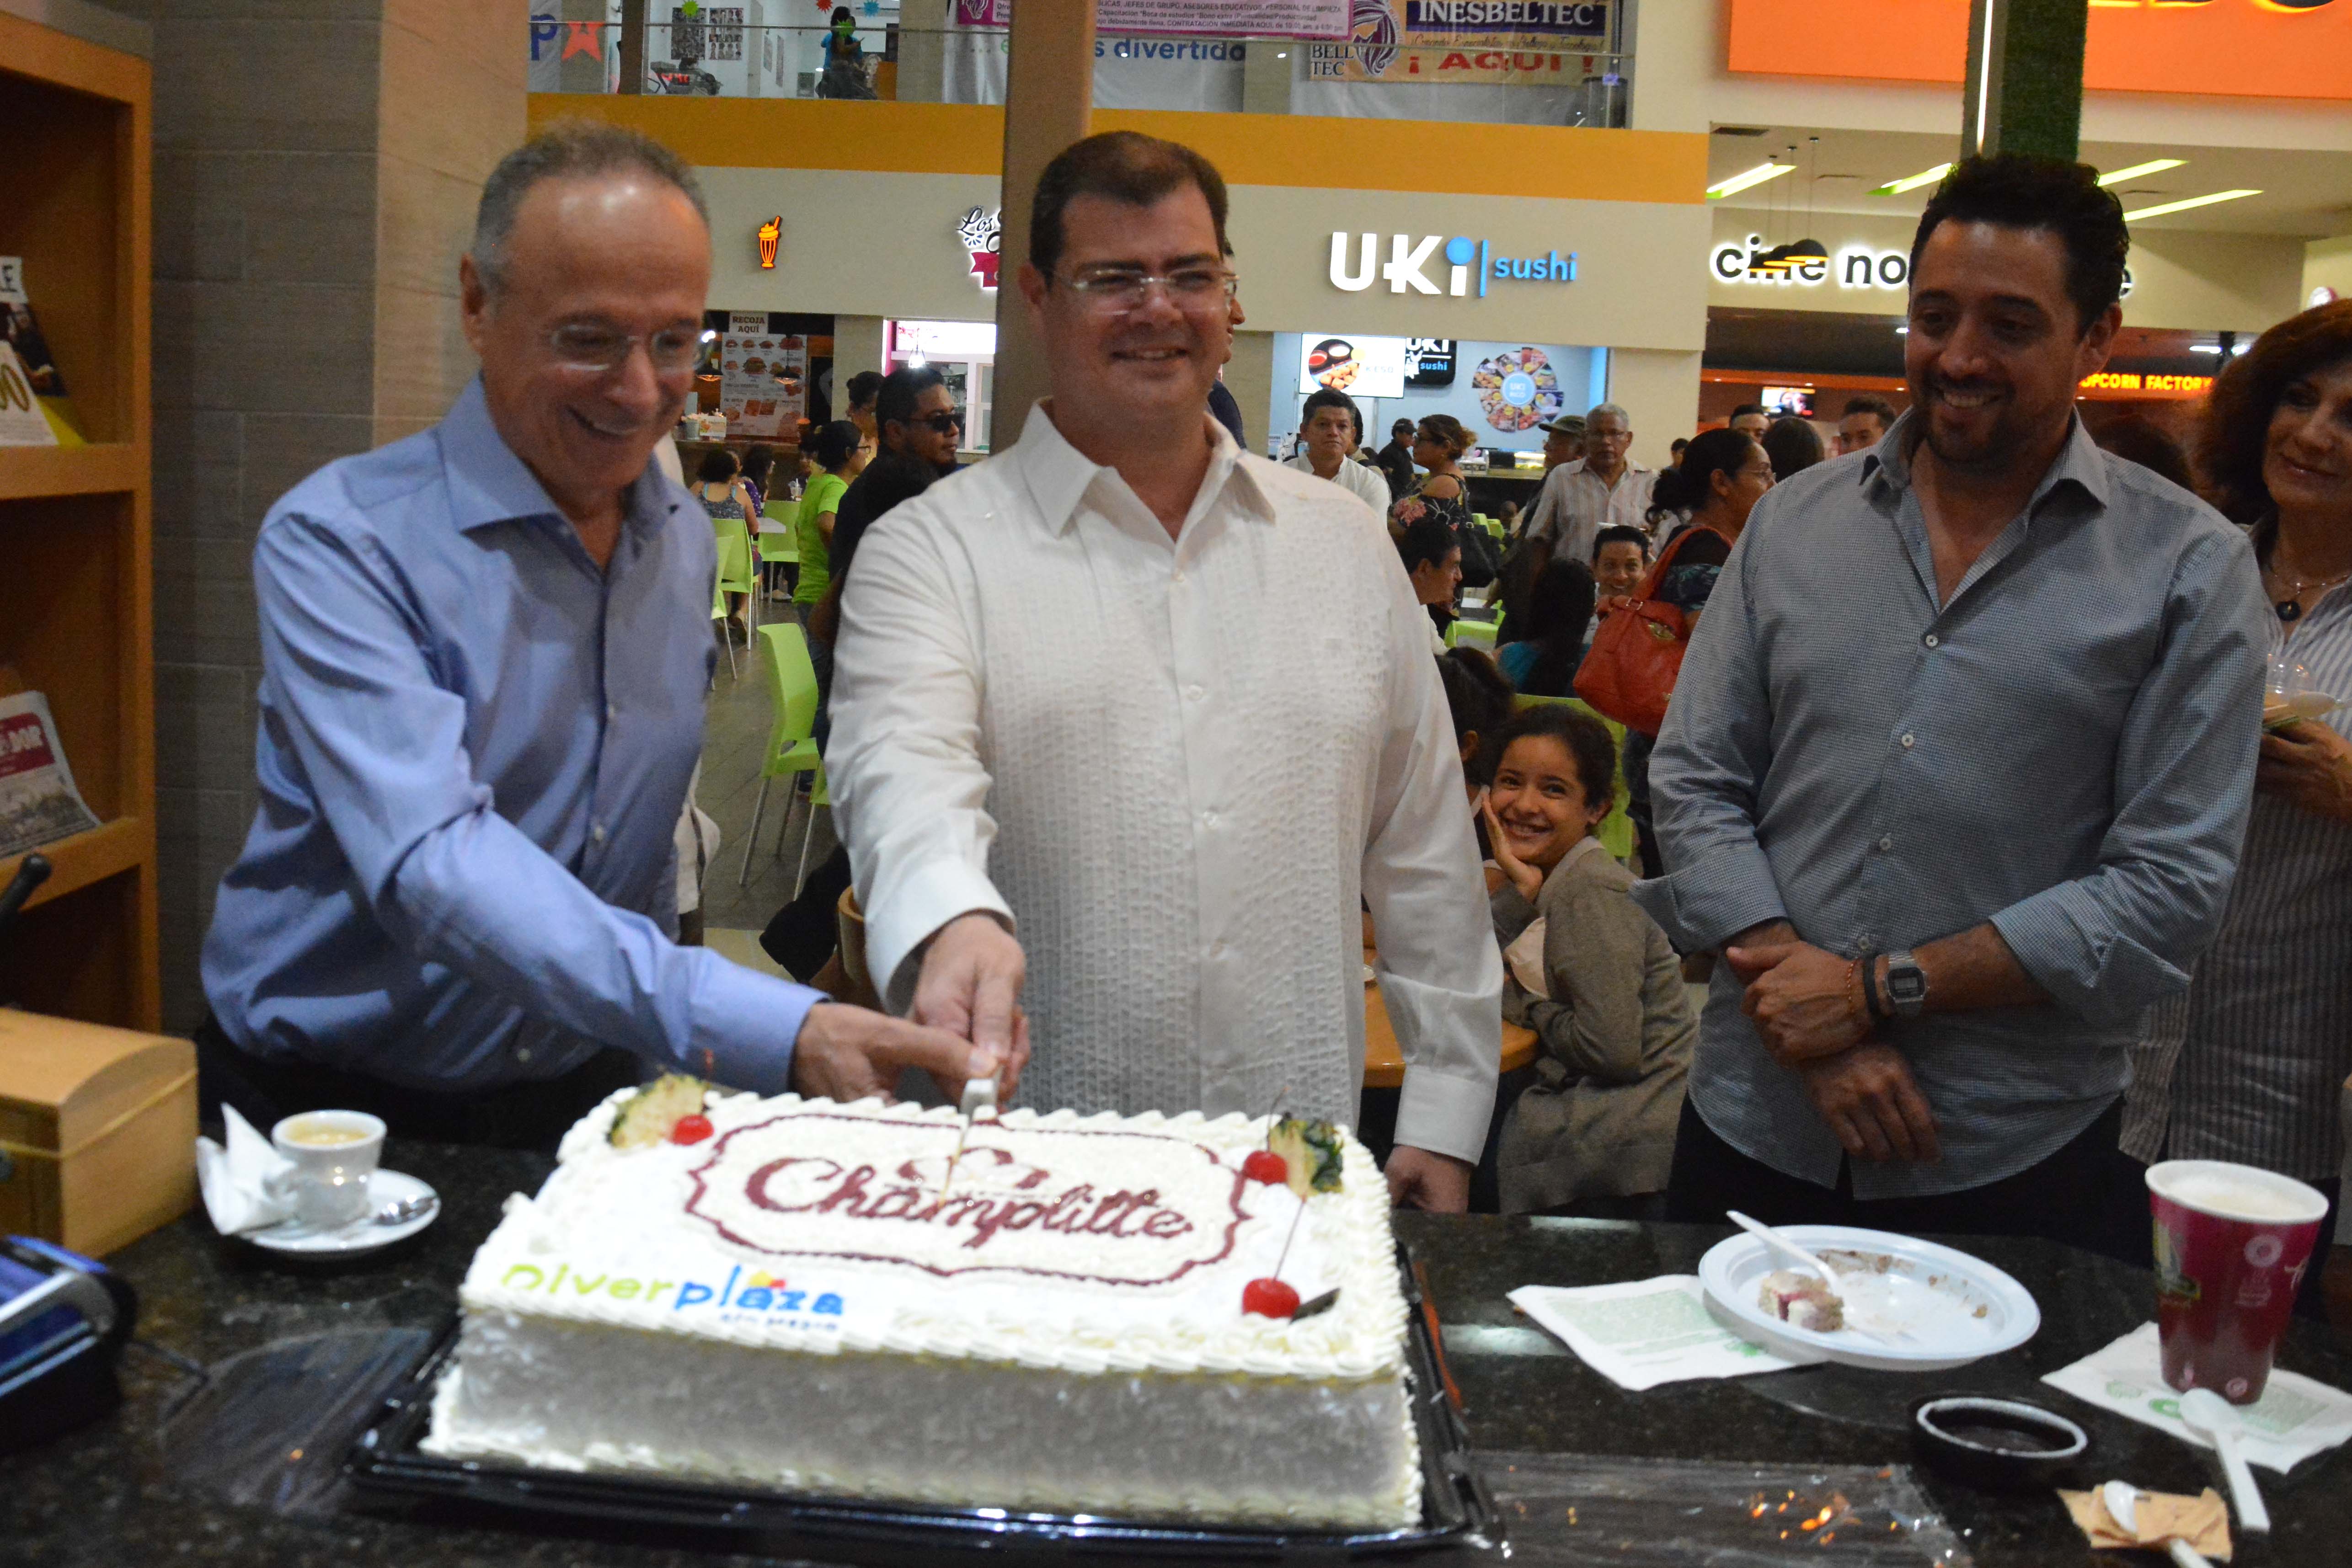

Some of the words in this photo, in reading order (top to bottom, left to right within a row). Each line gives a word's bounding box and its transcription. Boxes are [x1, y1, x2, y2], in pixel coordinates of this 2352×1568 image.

[1419, 1, 1594, 26] INESBELTEC
[1114, 37, 1245, 61] divertido
[1312, 45, 1353, 59] BELL
[1312, 61, 1345, 75] TEC
[956, 208, 995, 236] Los
[1494, 250, 1578, 281] sushi
[738, 325, 759, 334] AQUÍ
[1420, 361, 1447, 371] sushi
[2145, 374, 2213, 390] FACTORY
